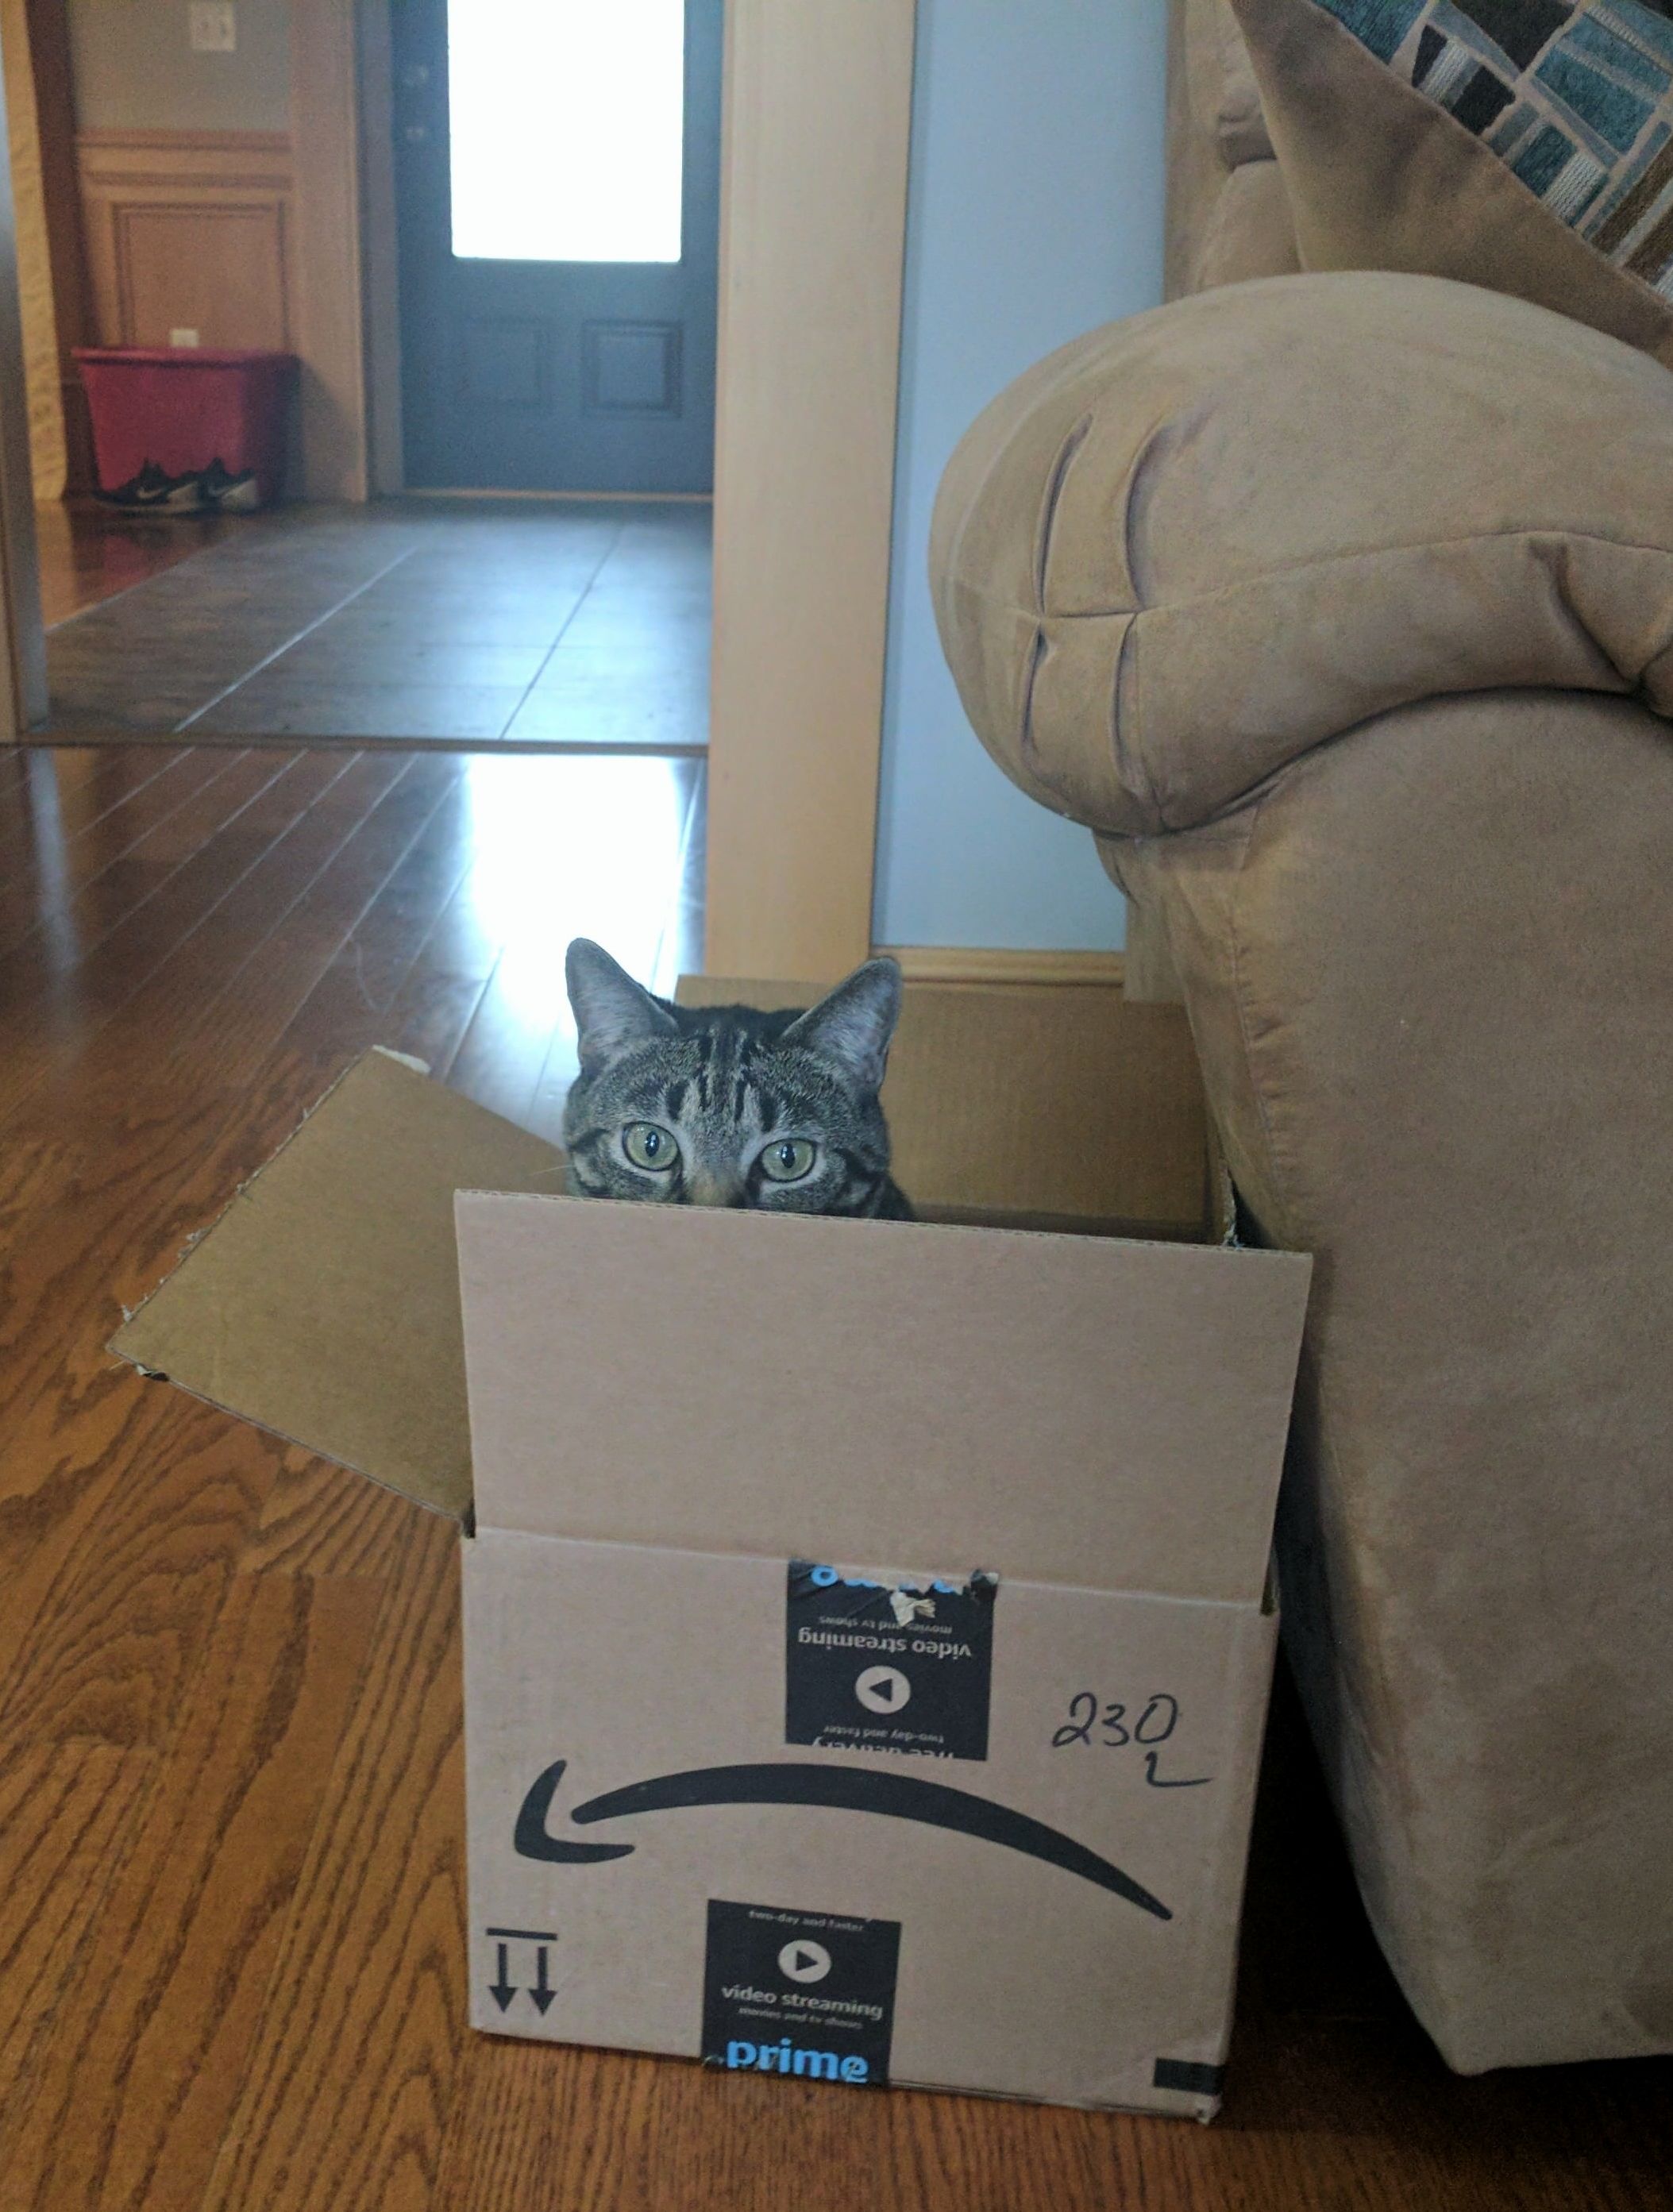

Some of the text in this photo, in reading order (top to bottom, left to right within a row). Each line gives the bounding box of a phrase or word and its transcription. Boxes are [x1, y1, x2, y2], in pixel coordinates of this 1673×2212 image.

[862, 1618, 877, 1628] tv
[798, 1627, 972, 1660] video streaming
[823, 1725, 945, 1744] two-day and faster
[1051, 1691, 1178, 1748] 230
[748, 1909, 799, 1925] two-day
[802, 1917, 827, 1928] and
[721, 1984, 884, 2021] video streaming
[726, 2037, 869, 2084] prime
